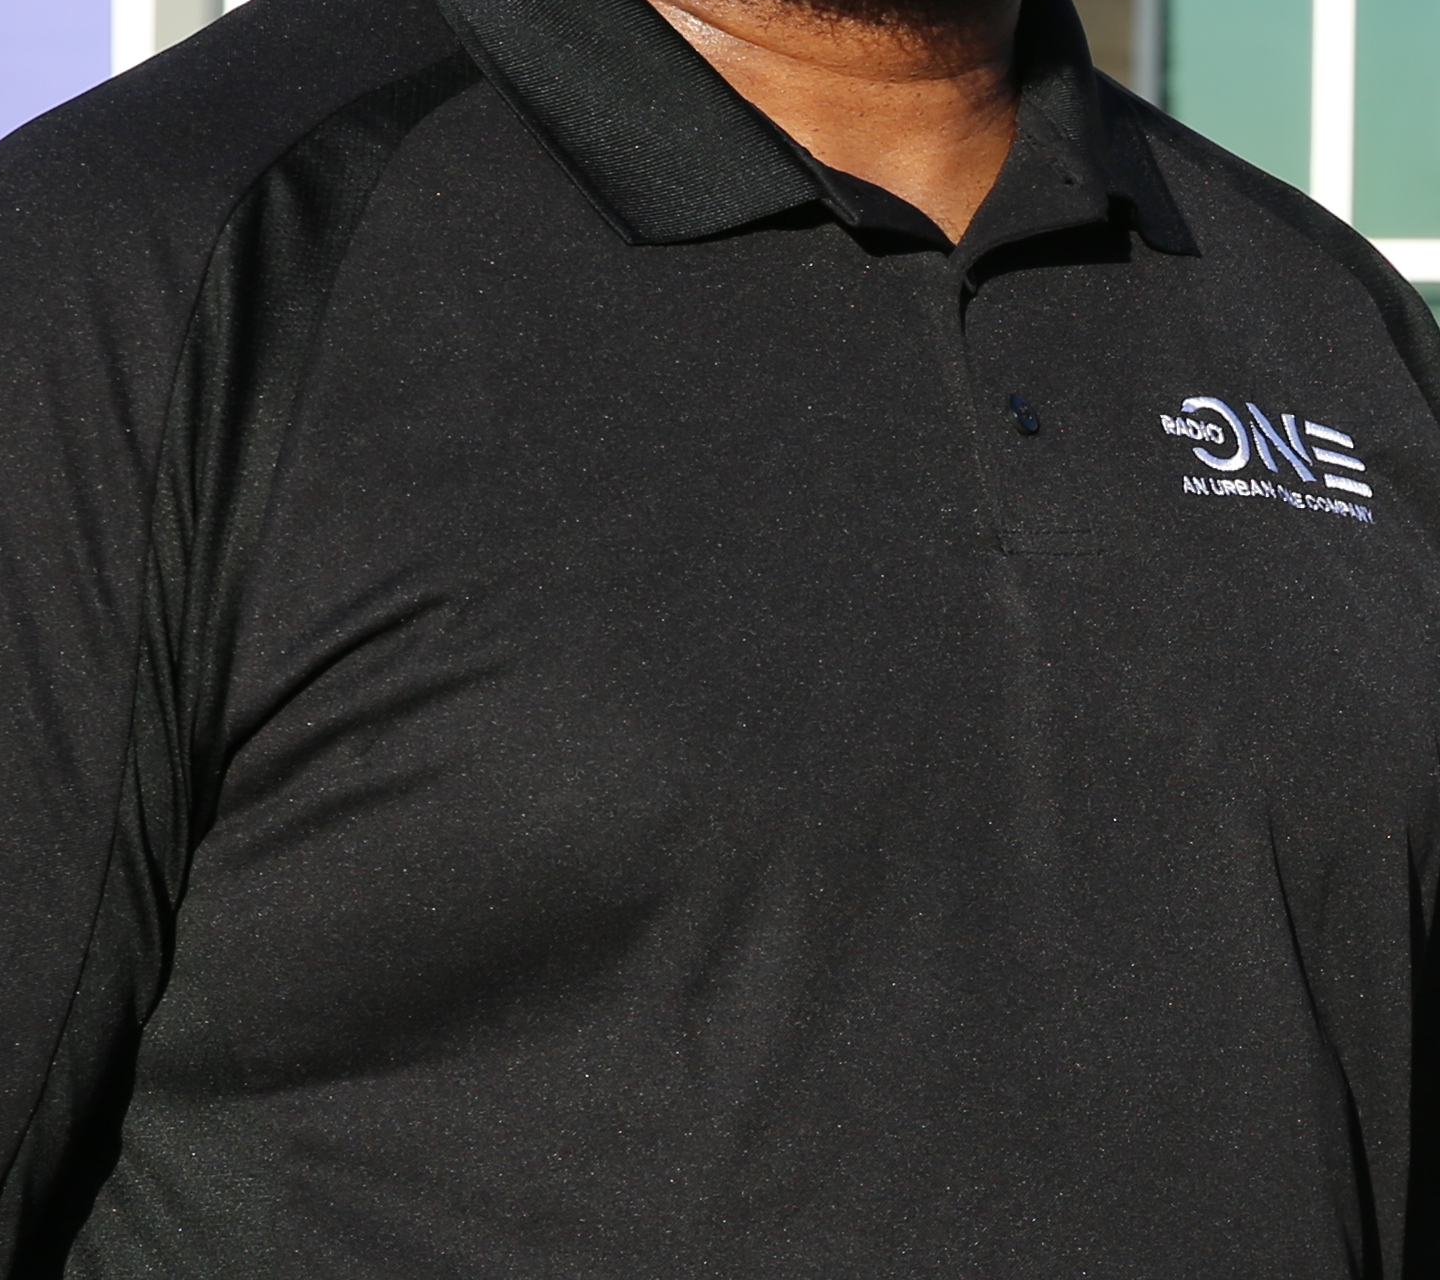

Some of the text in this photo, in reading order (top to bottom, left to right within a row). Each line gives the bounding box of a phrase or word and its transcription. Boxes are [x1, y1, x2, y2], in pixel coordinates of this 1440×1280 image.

[1160, 396, 1372, 498] RADIO ONE
[1183, 476, 1208, 497] AN
[1209, 478, 1277, 500] URBAN
[1305, 493, 1376, 524] COMPANY
